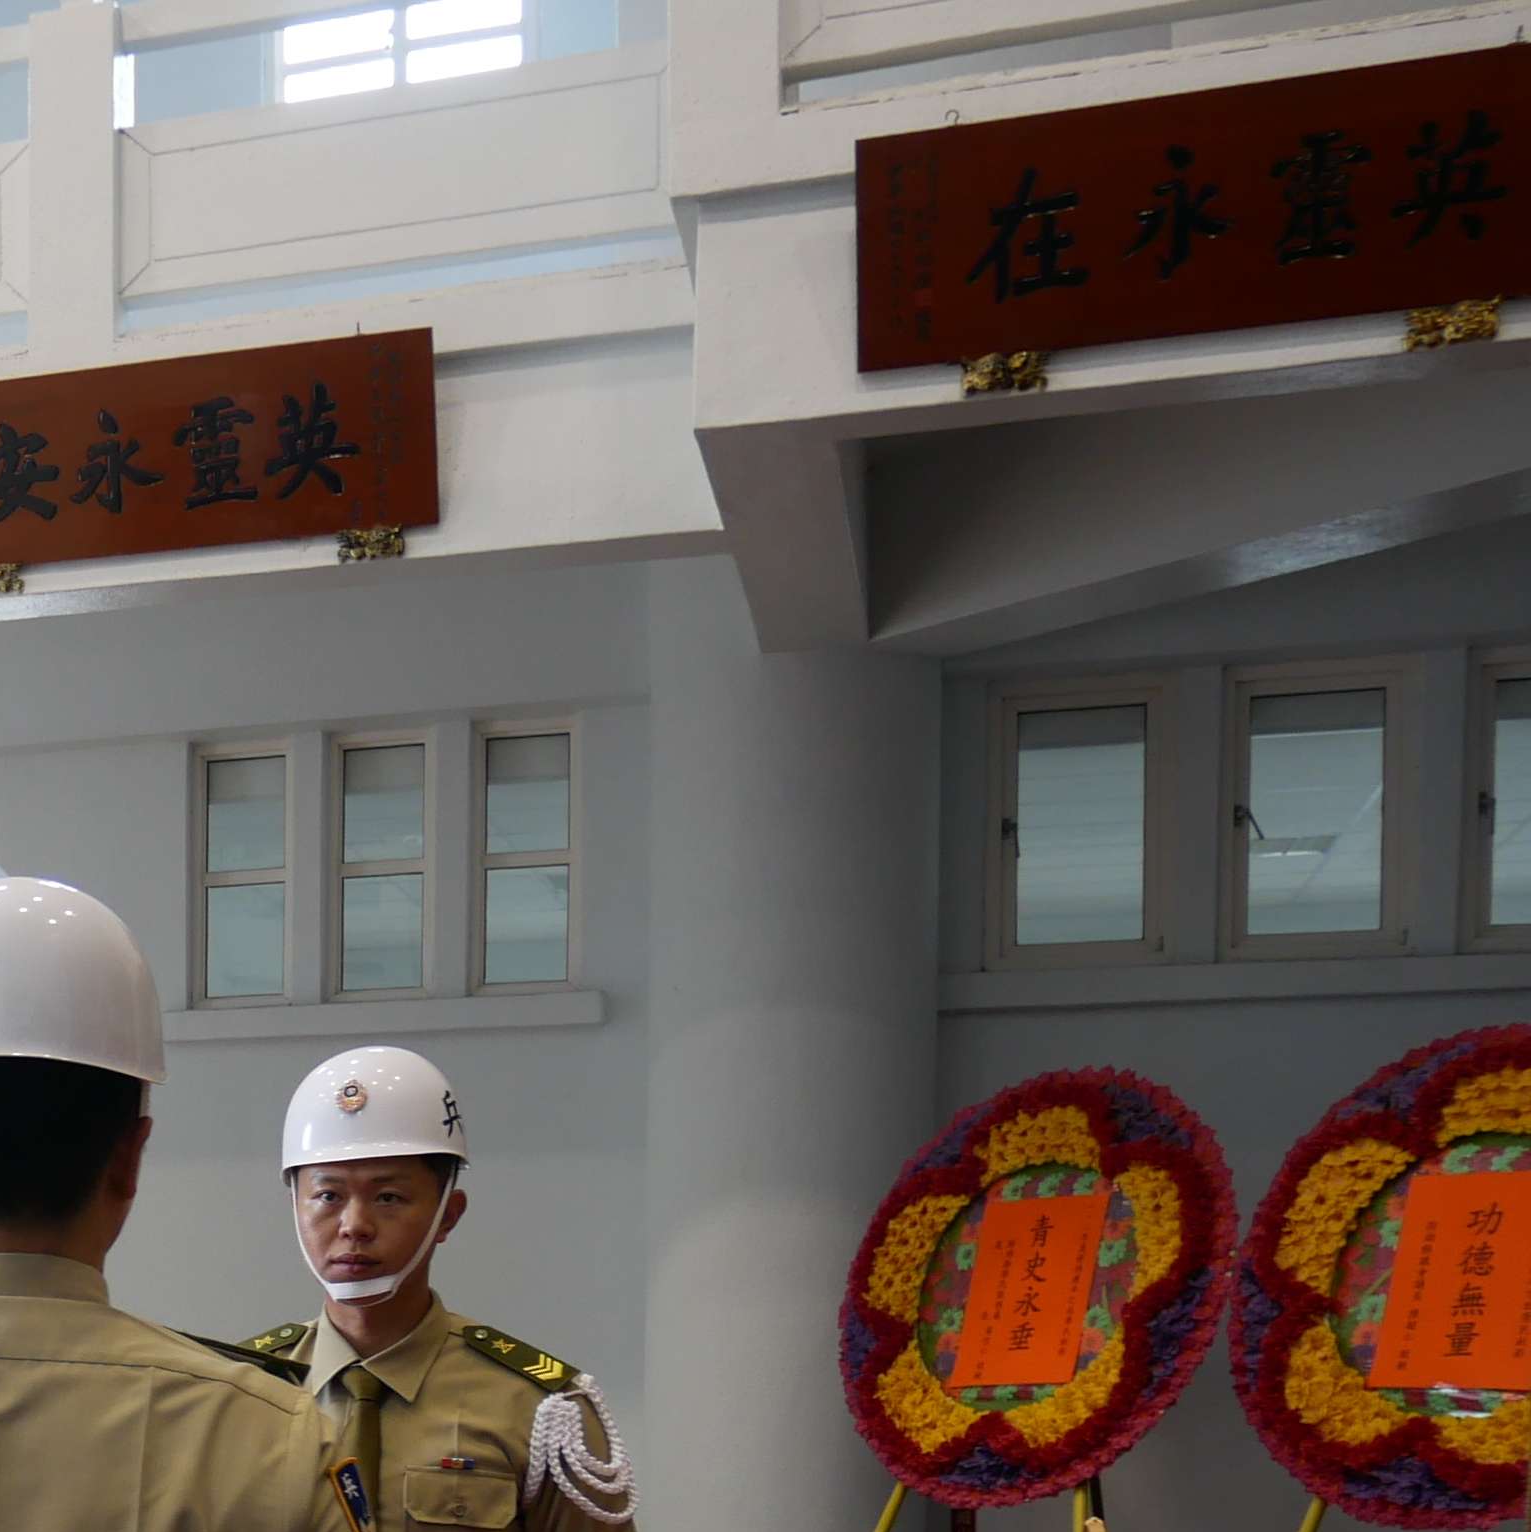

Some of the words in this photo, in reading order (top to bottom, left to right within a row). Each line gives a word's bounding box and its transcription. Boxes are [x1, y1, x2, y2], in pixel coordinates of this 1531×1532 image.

[965, 108, 1511, 304] 英靈永在
[1006, 1213, 1055, 1352] 青史永垂
[1442, 1201, 1505, 1358] 功德無量
